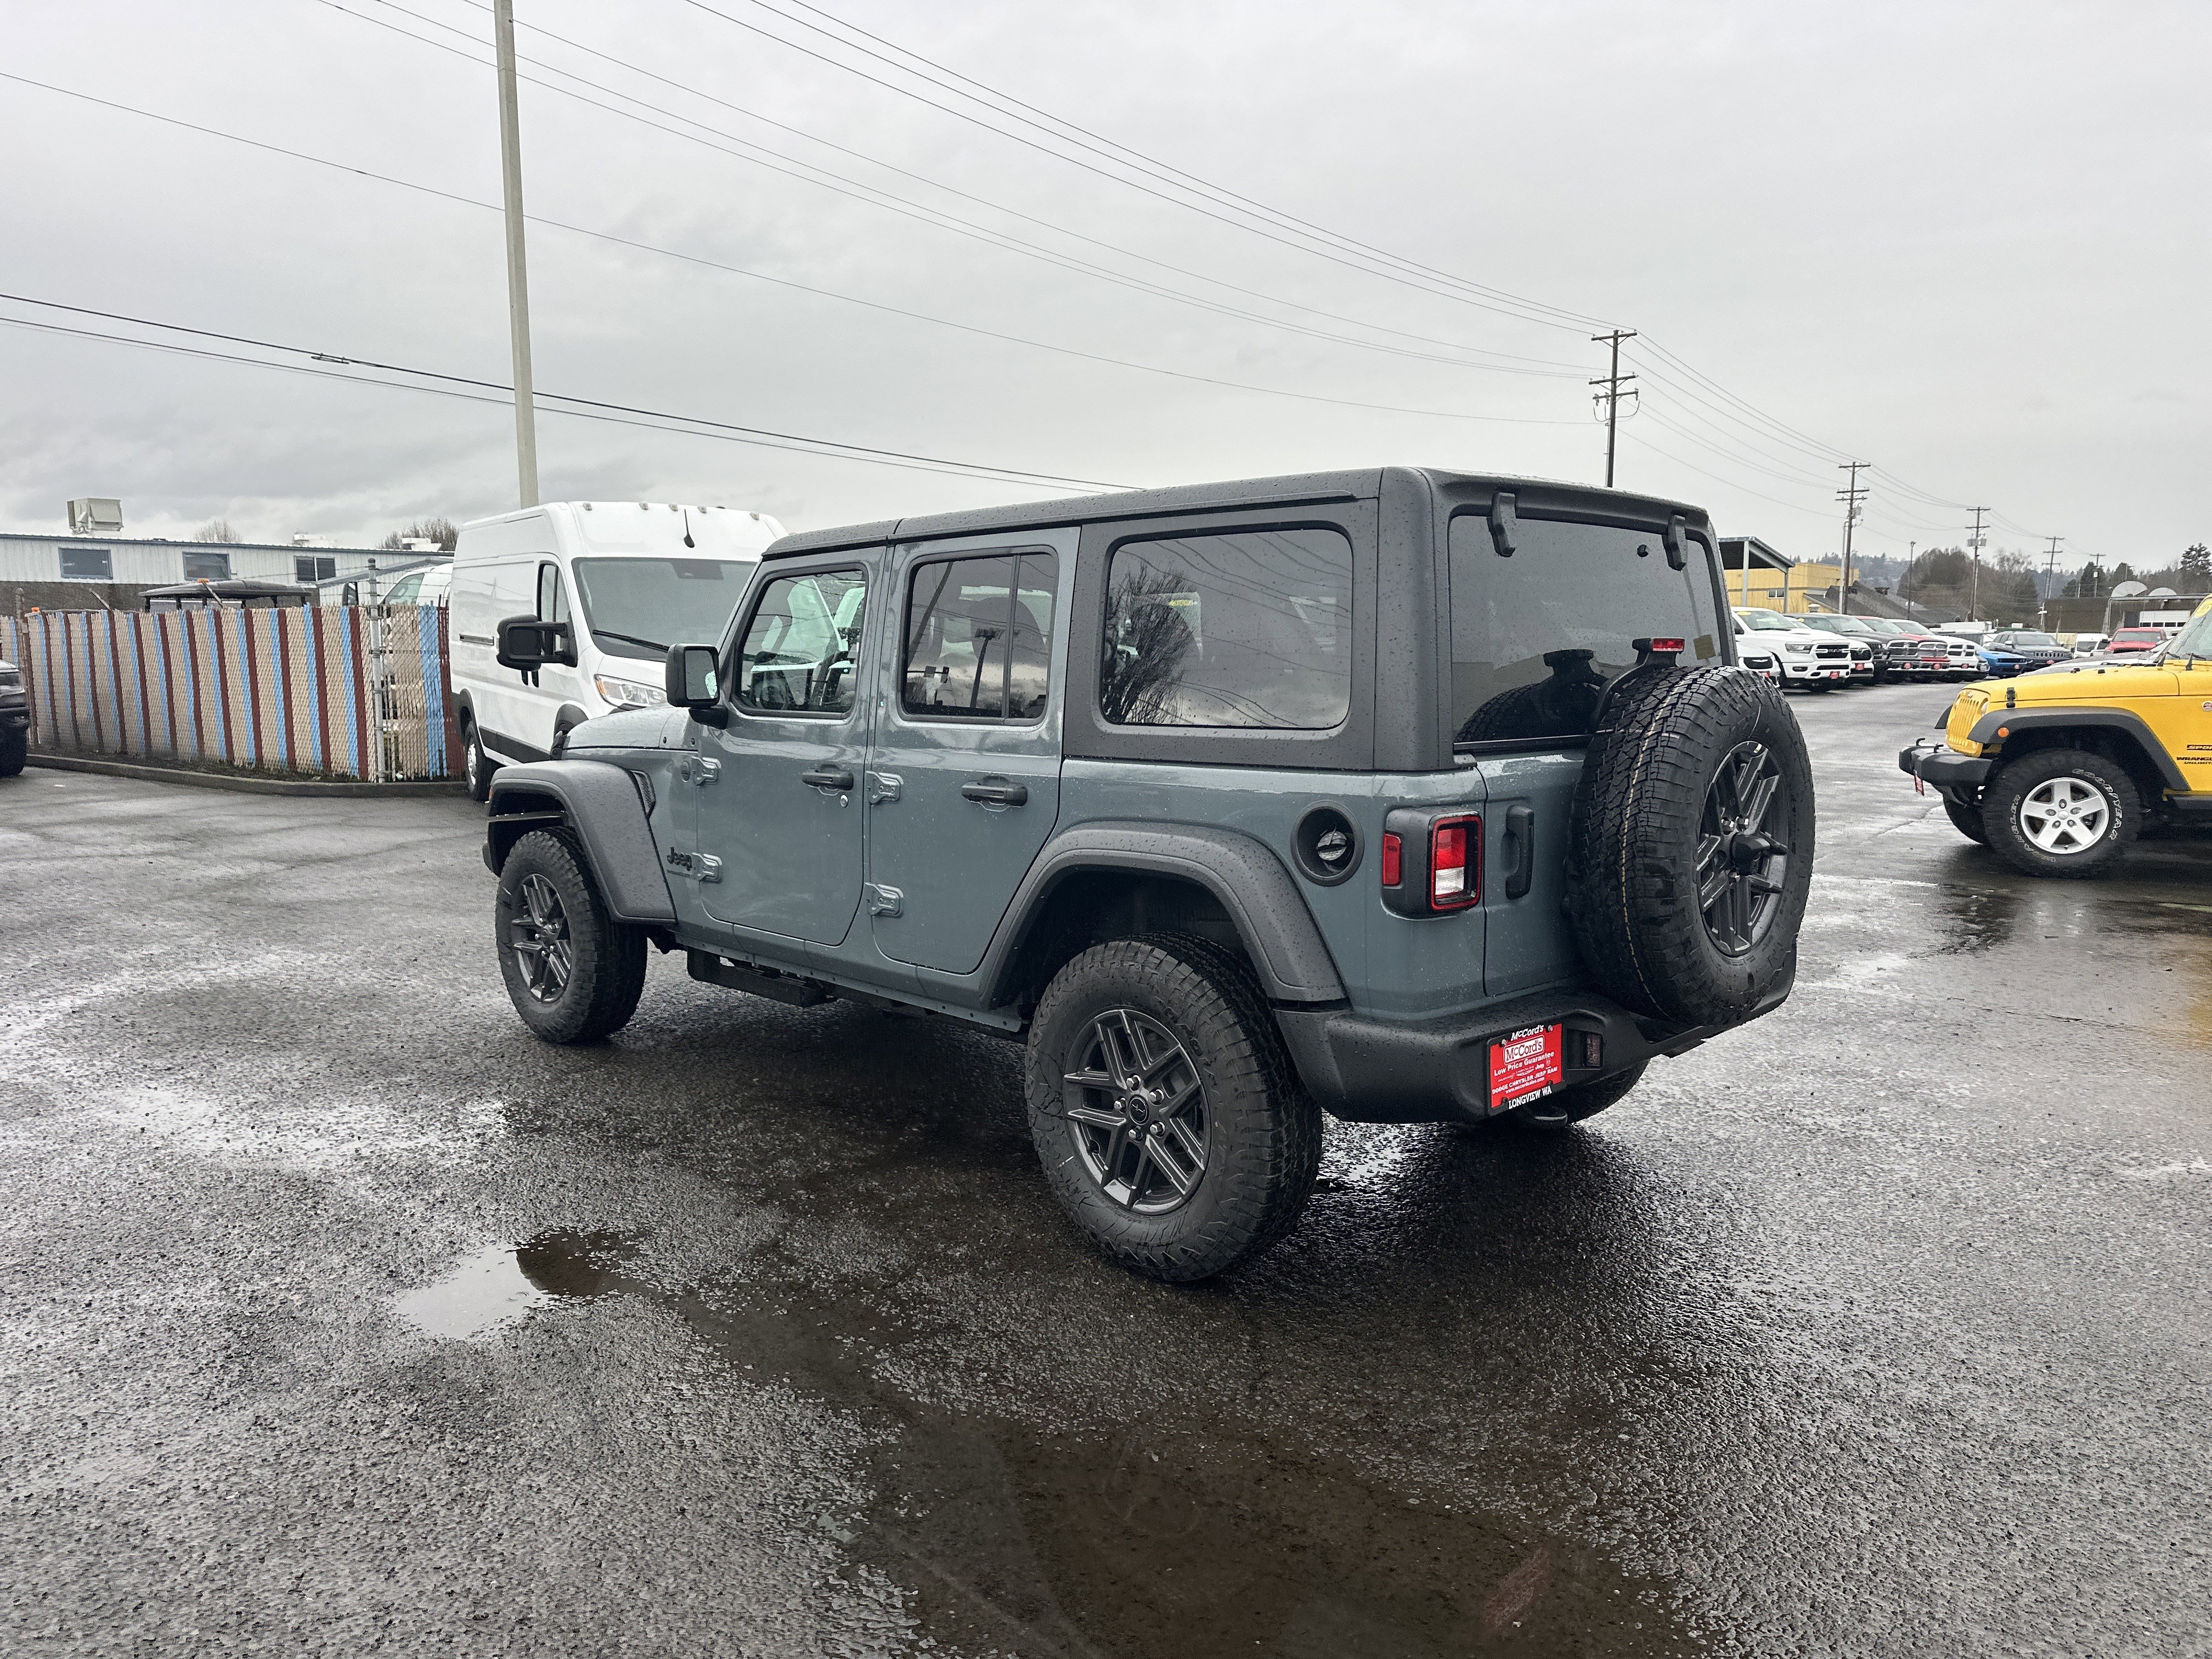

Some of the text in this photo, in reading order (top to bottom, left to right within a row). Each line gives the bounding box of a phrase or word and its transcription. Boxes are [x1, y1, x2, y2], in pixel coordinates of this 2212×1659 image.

[2072, 769, 2123, 840] GOODYEAR
[667, 846, 692, 871] Jeep
[1510, 1024, 1544, 1041] McCord's
[1506, 1040, 1542, 1062] McCord's
[1494, 1052, 1554, 1076] Low Price Guarantee
[1492, 1084, 1508, 1094] DODGE
[1509, 1075, 1533, 1088] CHRYSLER
[1534, 1070, 1547, 1079] JEEP
[1508, 1086, 1552, 1109] LONGVIEW WA
